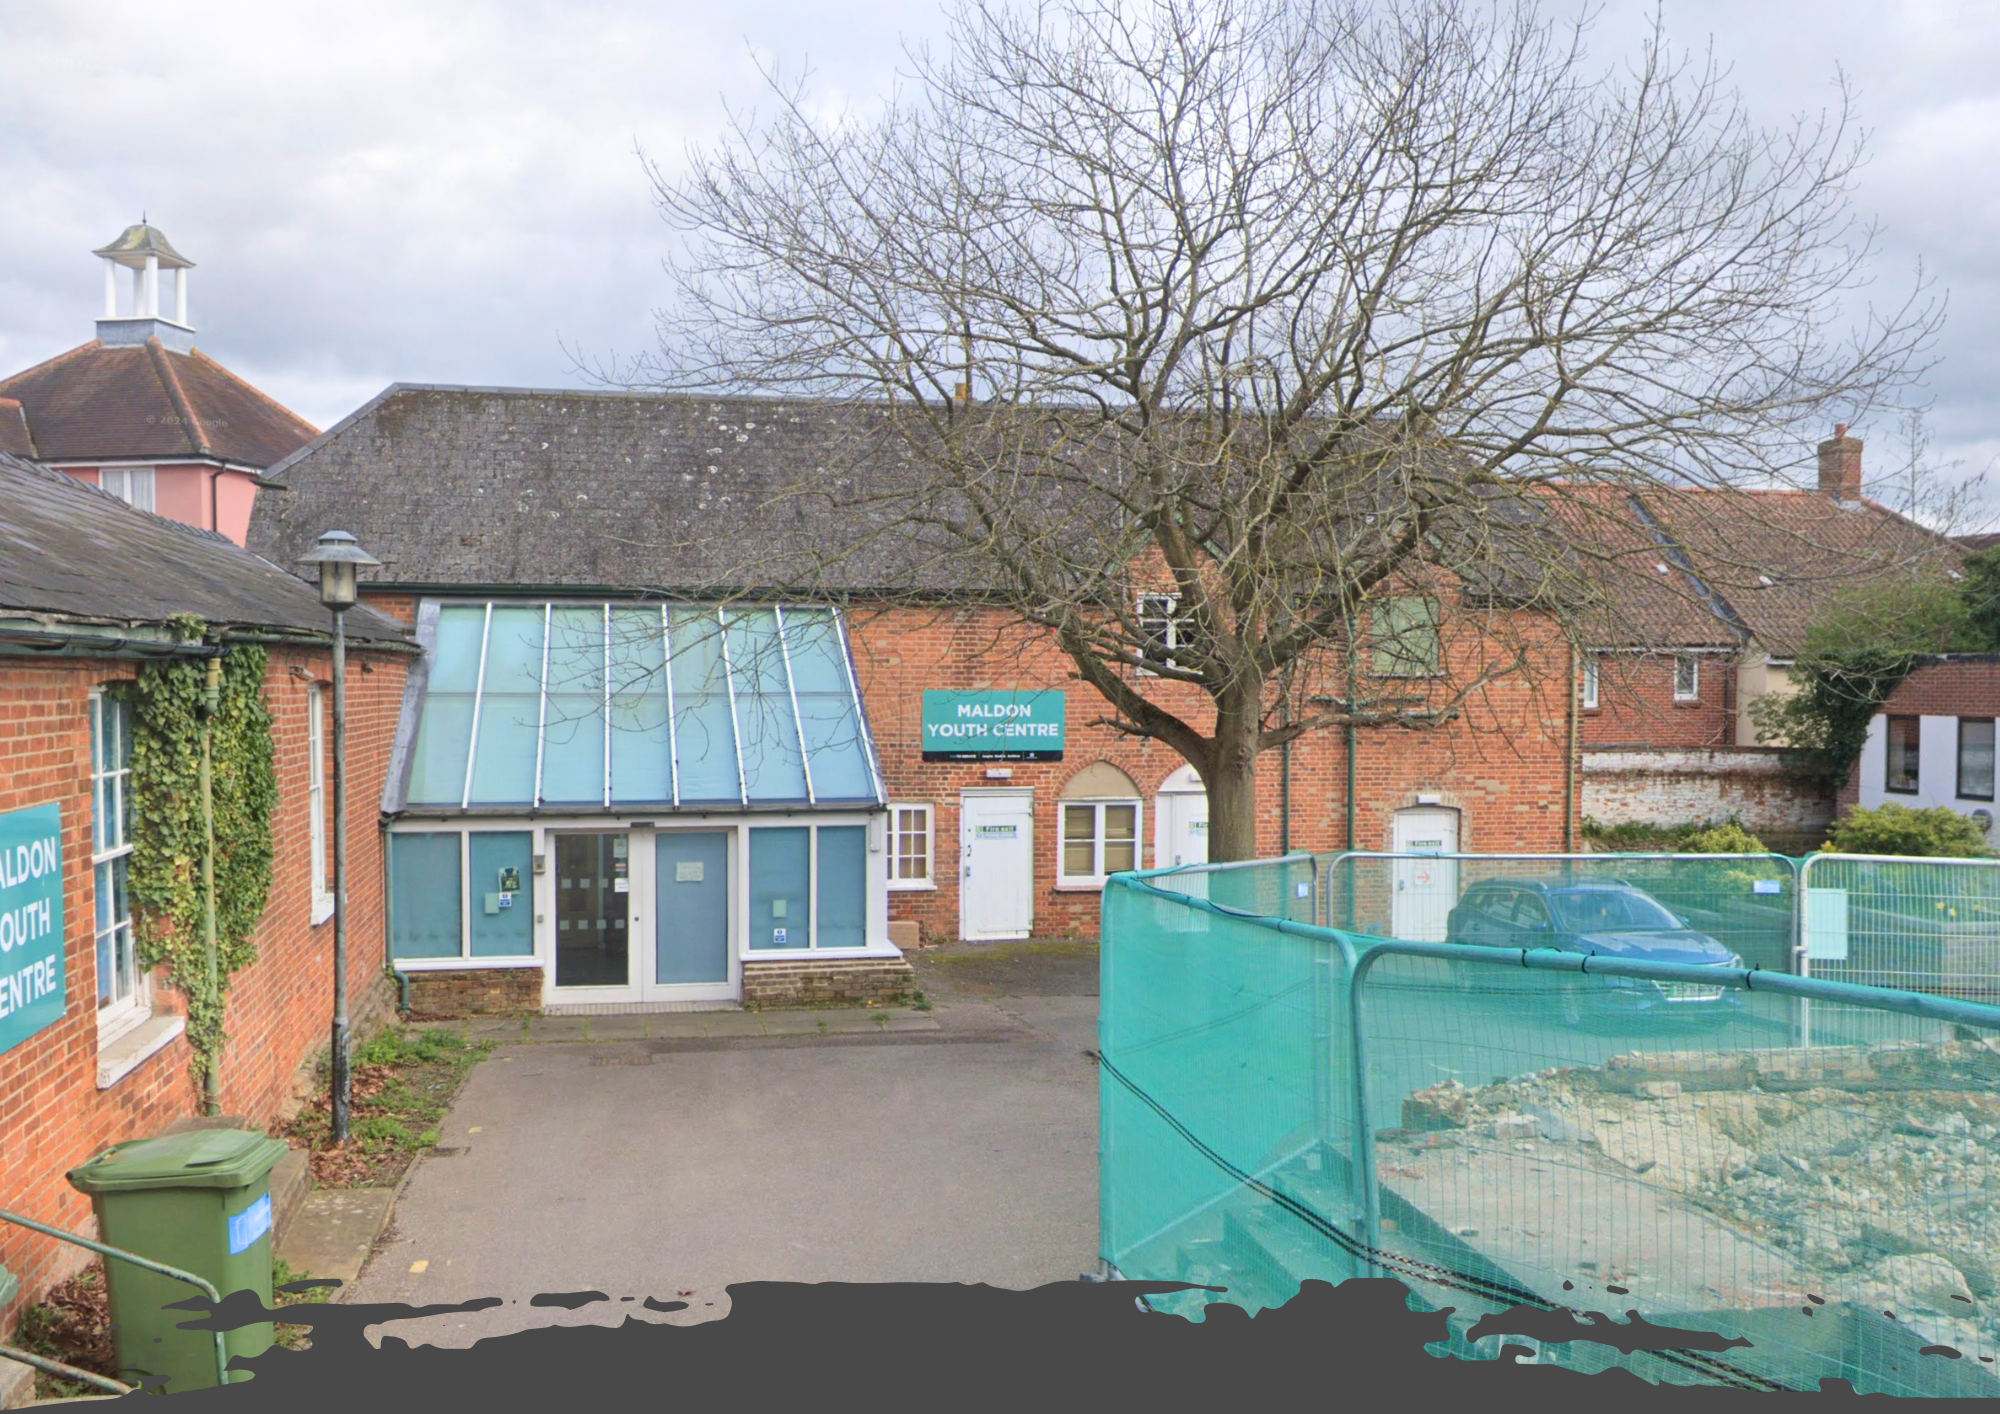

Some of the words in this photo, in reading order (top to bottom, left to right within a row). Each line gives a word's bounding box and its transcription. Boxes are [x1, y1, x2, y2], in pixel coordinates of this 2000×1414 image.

[957, 704, 1031, 718] MALDON
[928, 723, 988, 737] YOUTH
[993, 723, 1059, 736] CENTRE
